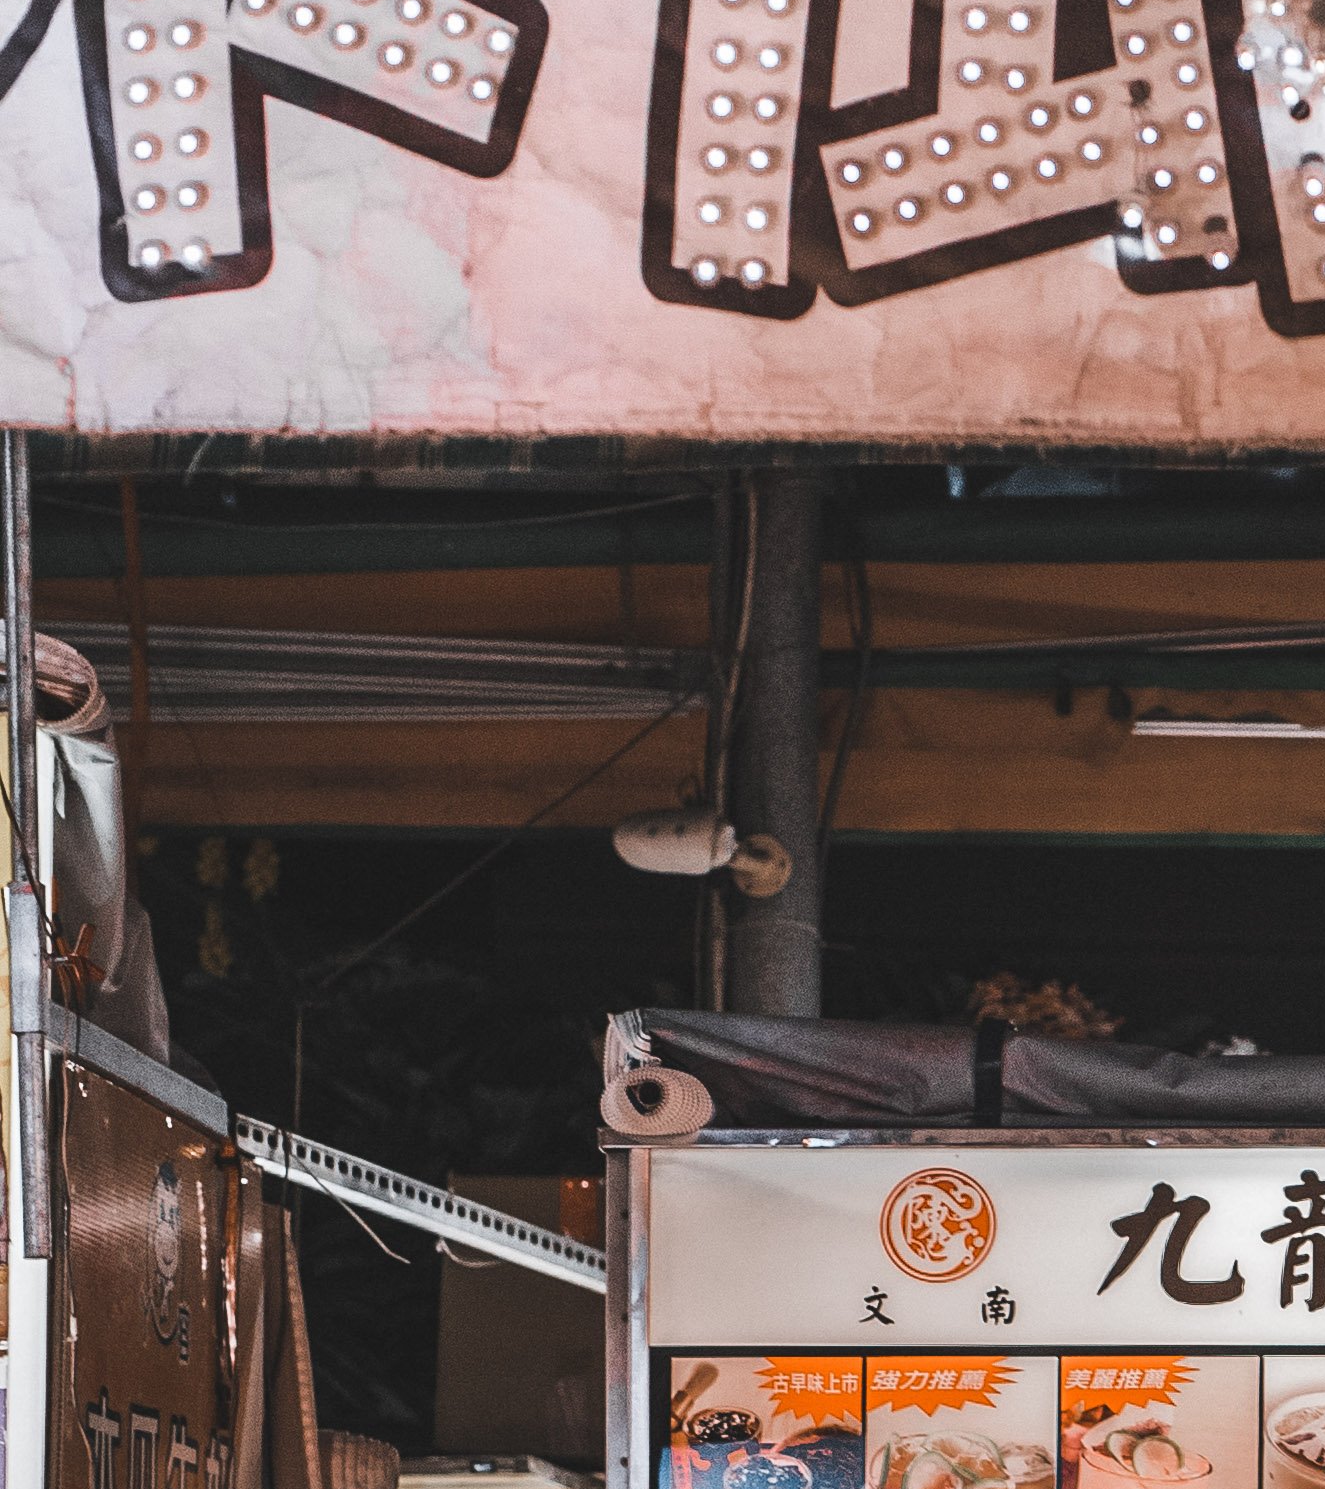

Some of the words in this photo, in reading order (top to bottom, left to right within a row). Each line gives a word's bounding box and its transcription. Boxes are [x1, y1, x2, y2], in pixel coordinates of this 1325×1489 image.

[772, 1371, 860, 1394] 古早味上市
